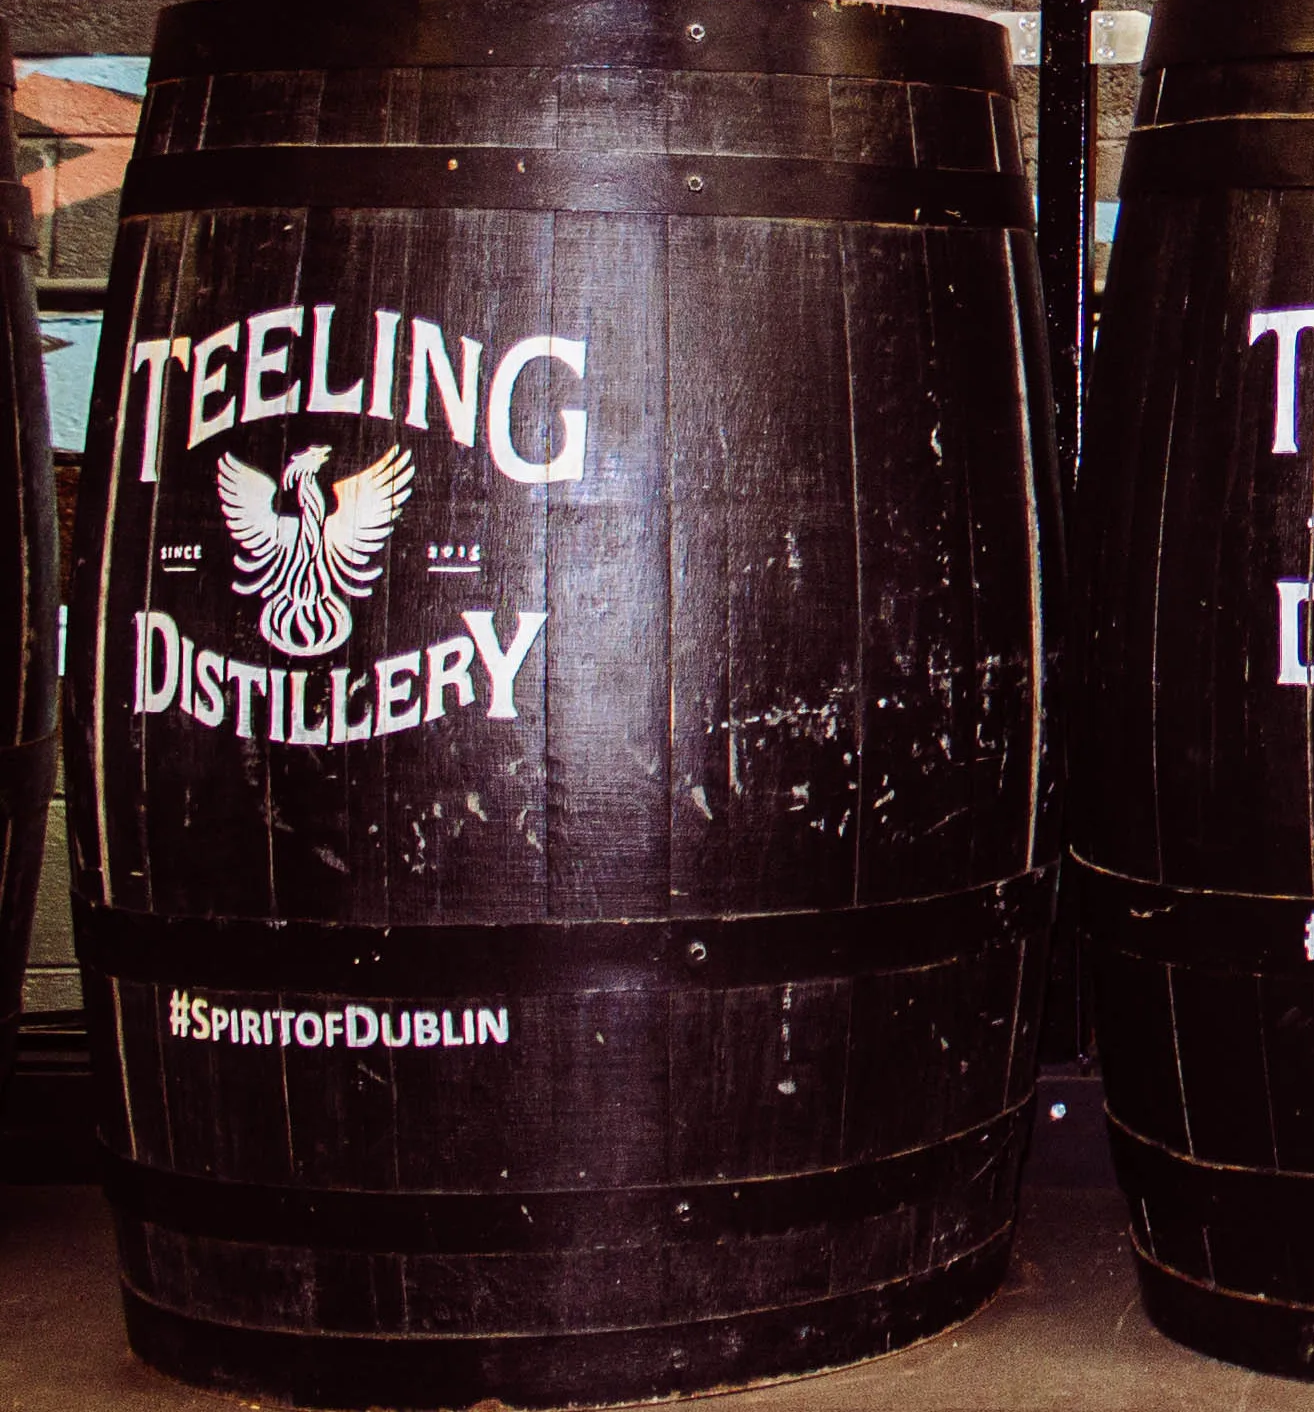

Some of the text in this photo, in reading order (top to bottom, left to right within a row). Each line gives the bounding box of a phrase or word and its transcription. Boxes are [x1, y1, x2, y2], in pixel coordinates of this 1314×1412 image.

[133, 304, 588, 484] TEELING
[160, 545, 202, 560] SINCE
[134, 611, 549, 746] DISTILLERY
